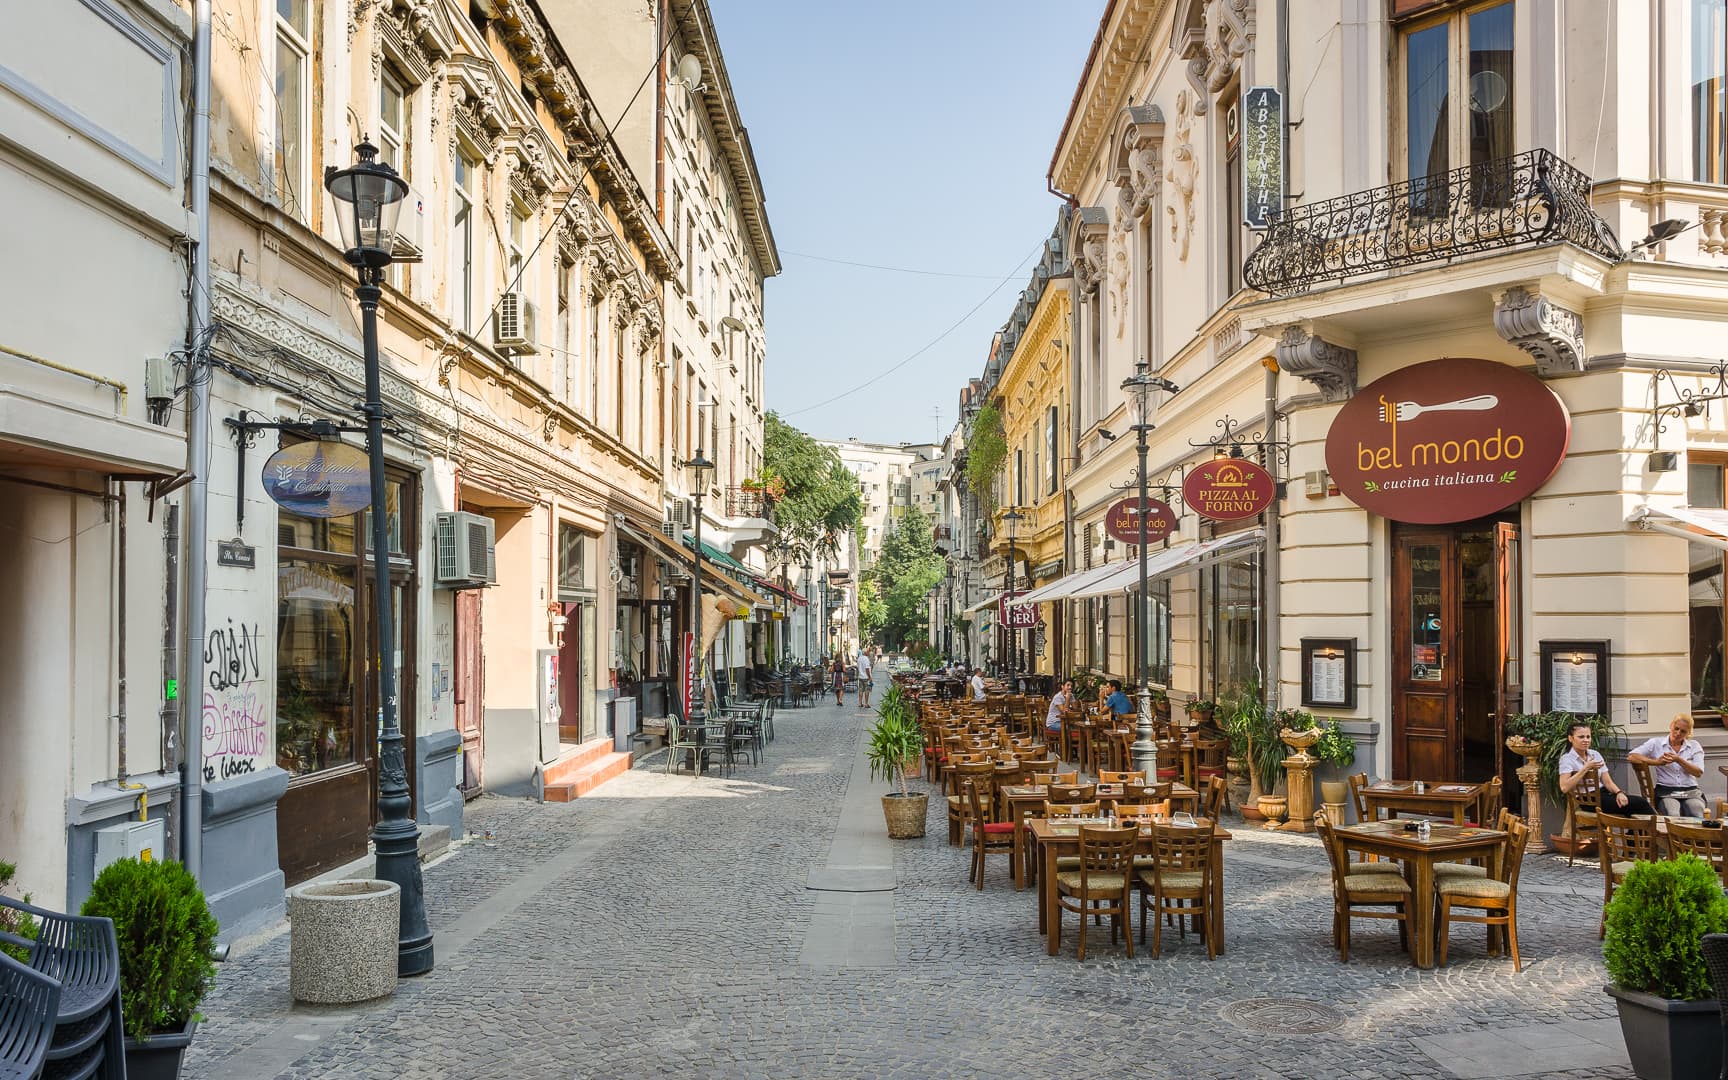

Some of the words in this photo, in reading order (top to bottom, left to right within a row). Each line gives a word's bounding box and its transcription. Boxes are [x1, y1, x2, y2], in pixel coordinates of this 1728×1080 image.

[1257, 91, 1269, 220] ABSINTHE
[1412, 428, 1524, 466] mondo
[1383, 476, 1430, 490] cucina
[1434, 471, 1495, 486] italiana
[1199, 490, 1238, 501] PIZZA
[1242, 490, 1260, 501] AL
[1205, 501, 1254, 512] FORNO
[1116, 515, 1131, 528] bel
[1133, 517, 1167, 528] mndo
